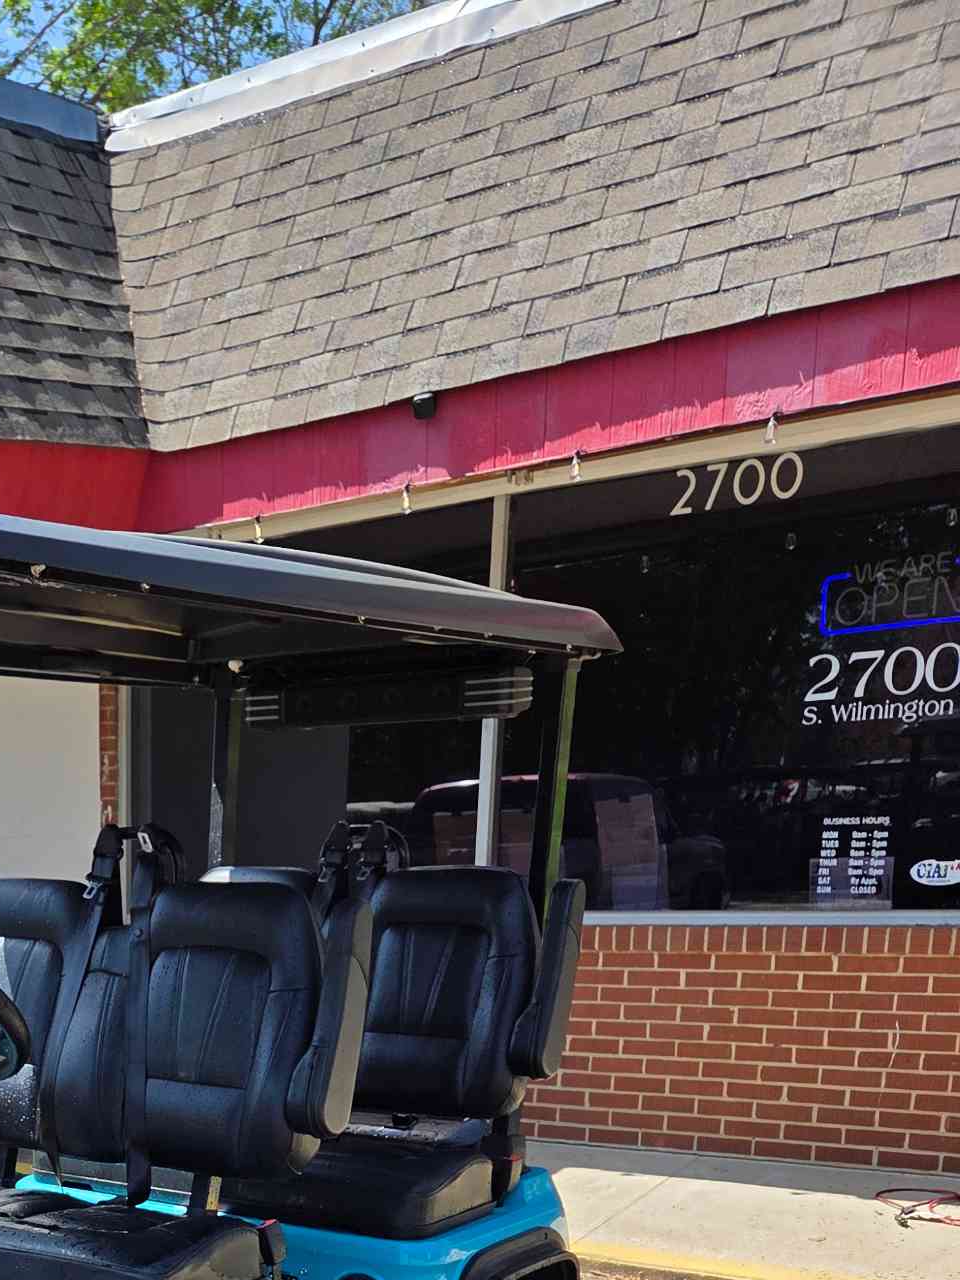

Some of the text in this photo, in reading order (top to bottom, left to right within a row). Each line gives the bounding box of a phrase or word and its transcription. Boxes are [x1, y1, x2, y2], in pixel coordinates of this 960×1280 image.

[670, 452, 804, 516] 2700
[854, 551, 953, 584] WE ARE
[803, 642, 960, 702] 2700
[801, 698, 953, 725] S. Wilmington
[862, 816, 890, 826] HOURS
